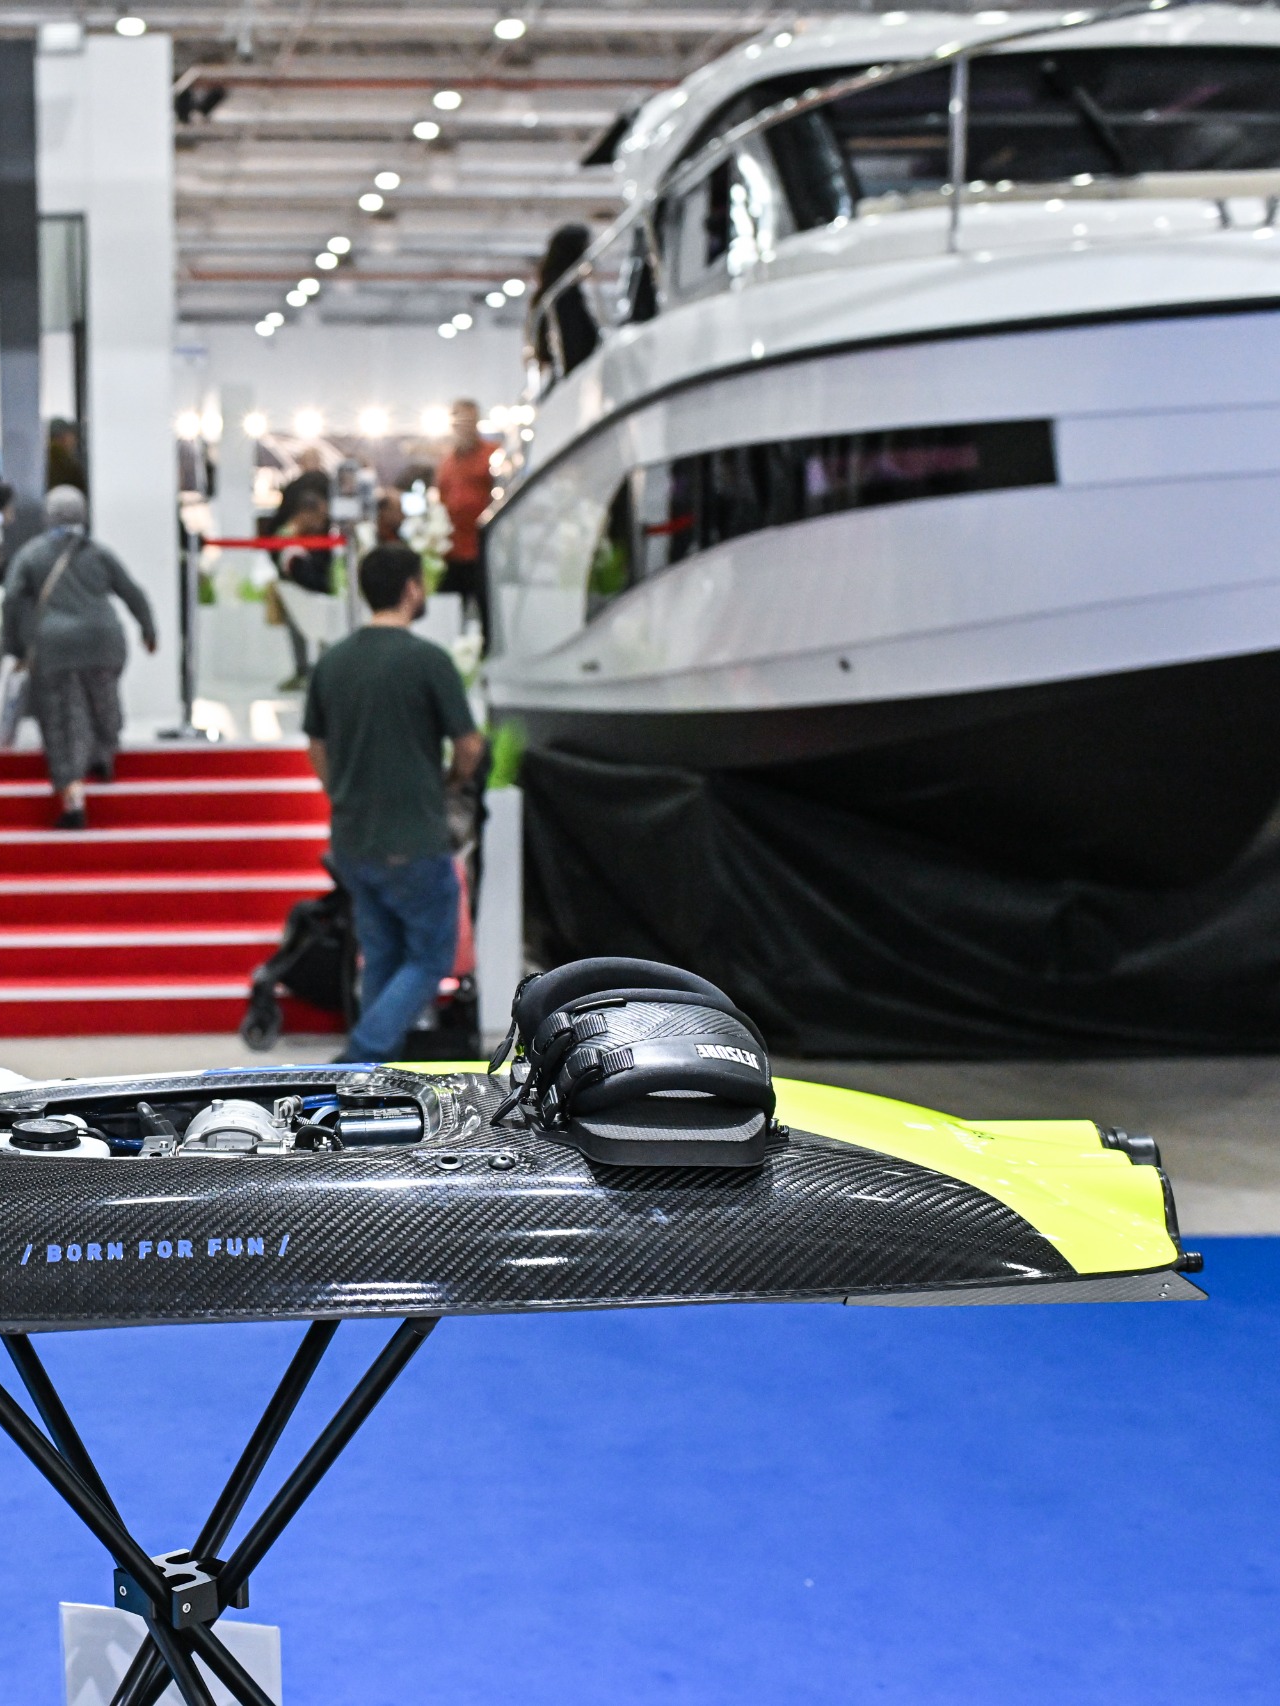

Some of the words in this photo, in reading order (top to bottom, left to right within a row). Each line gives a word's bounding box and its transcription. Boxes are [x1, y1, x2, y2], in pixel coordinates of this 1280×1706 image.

[47, 1242, 123, 1262] BORN
[139, 1240, 192, 1259] FOR
[208, 1238, 264, 1256] FUN
